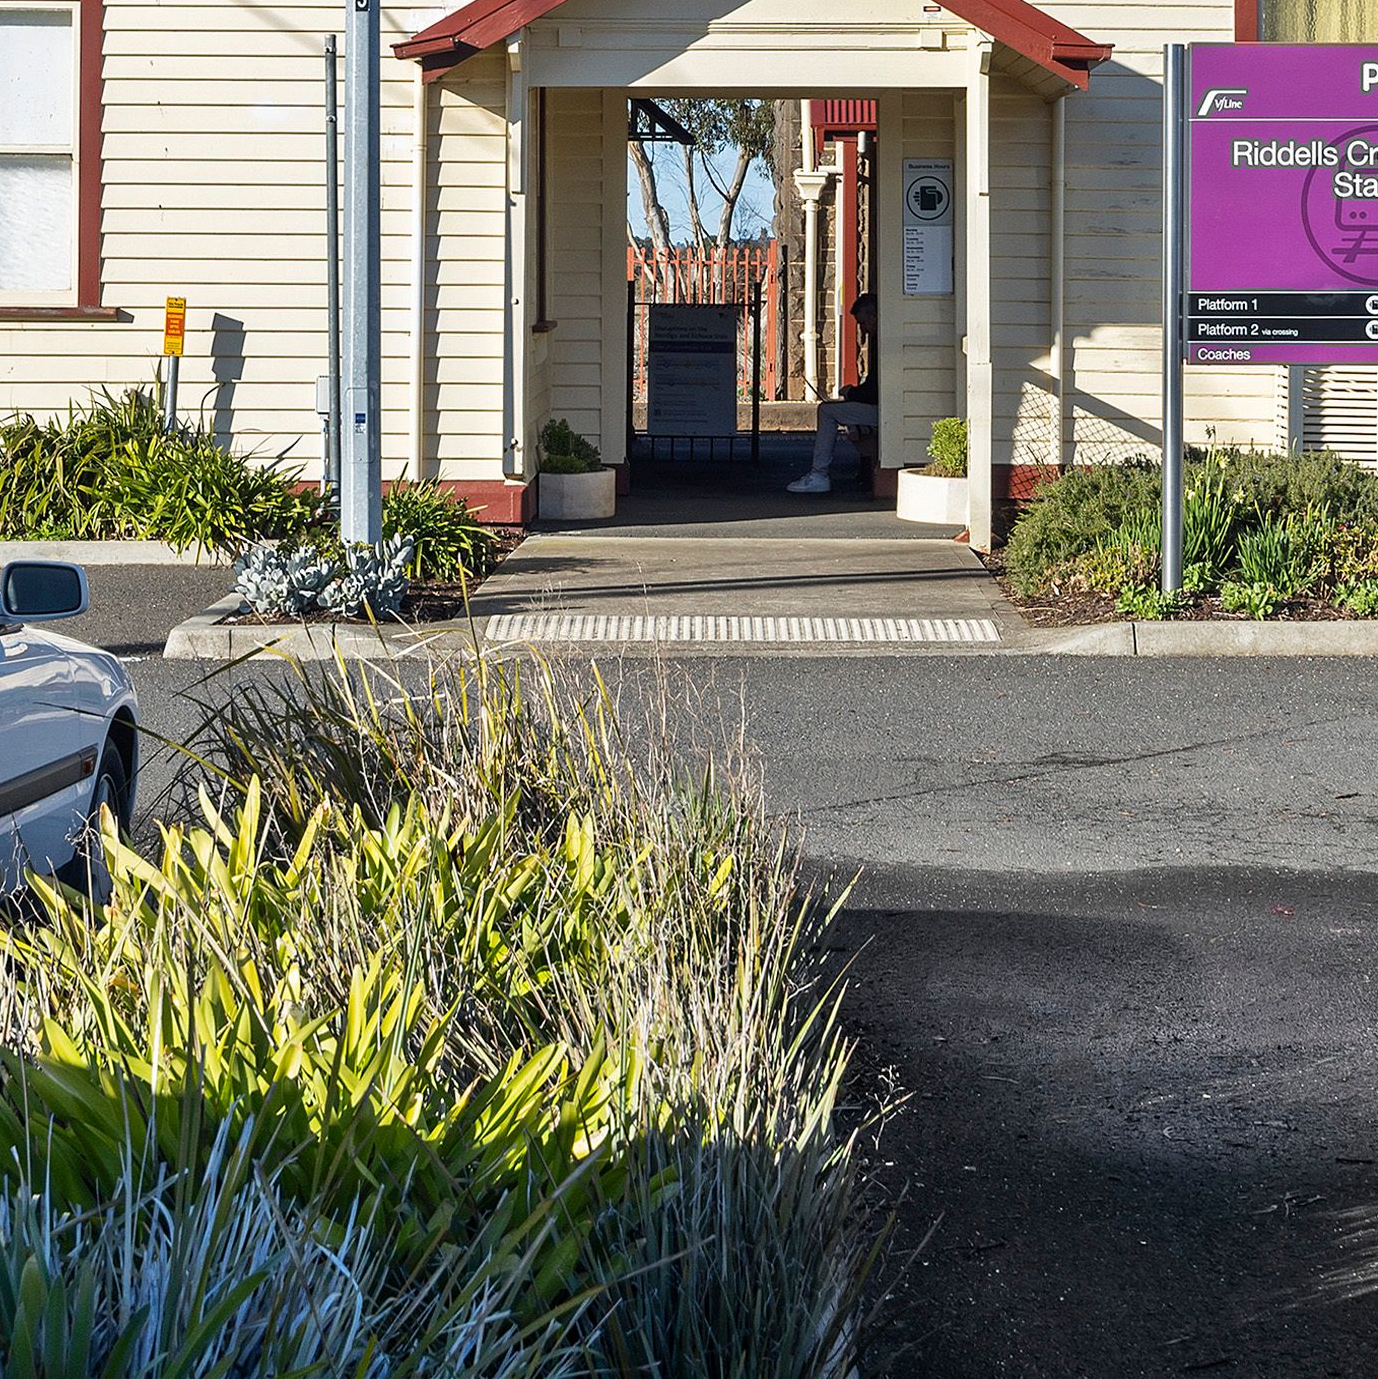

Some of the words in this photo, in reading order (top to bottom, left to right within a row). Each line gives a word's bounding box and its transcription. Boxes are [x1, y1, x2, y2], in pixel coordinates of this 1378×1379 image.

[1233, 141, 1338, 166] Riddells
[1198, 298, 1248, 311] Platform
[1251, 298, 1258, 311] 1
[1198, 323, 1247, 336] Platform
[1250, 323, 1259, 336] 2
[1261, 328, 1271, 336] via
[1271, 328, 1299, 337] crossing
[1198, 348, 1251, 360] Coaches
